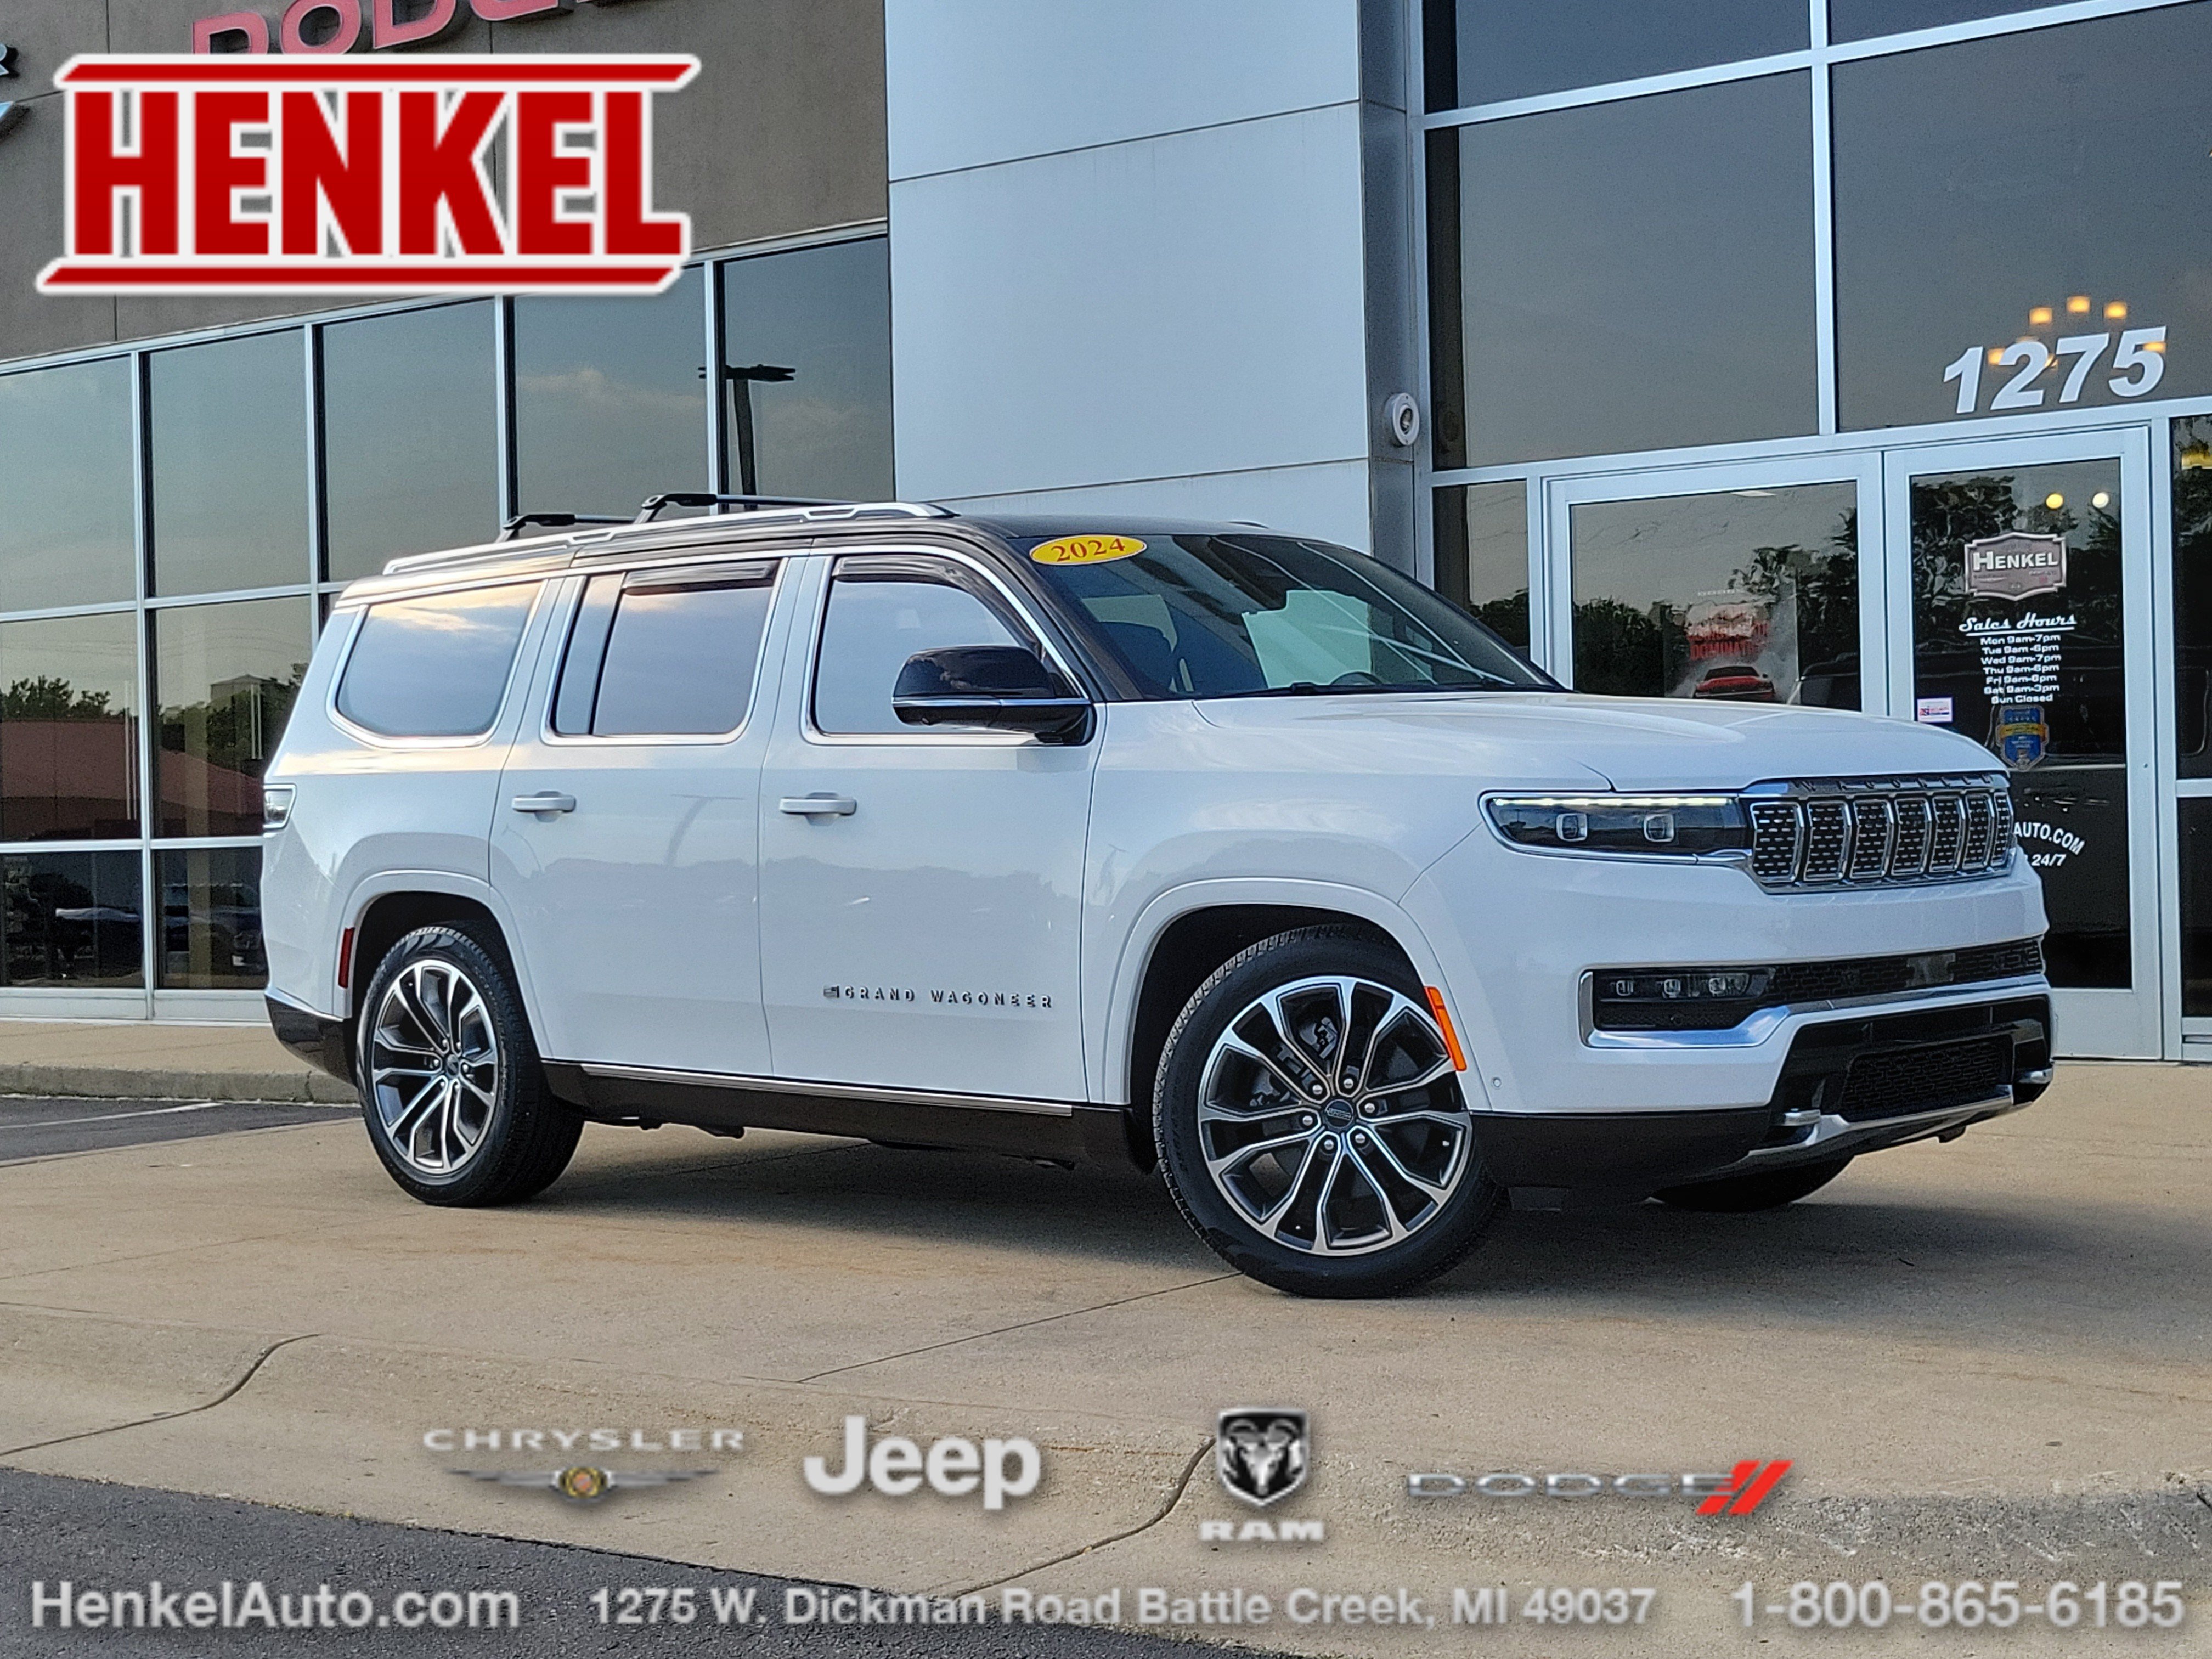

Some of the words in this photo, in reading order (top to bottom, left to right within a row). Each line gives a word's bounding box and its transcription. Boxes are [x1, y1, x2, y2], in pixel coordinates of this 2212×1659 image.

[1943, 325, 2166, 414] 1275
[1051, 537, 1125, 562] 2024
[1972, 550, 2058, 572] HENKEL
[1959, 617, 2012, 631] Sales
[2016, 612, 2078, 628] Hours
[1980, 636, 2005, 645] Mon
[1981, 656, 2006, 665] Wed
[1983, 667, 2004, 675] Thu
[2015, 693, 2053, 703] Closed
[2031, 853, 2067, 866] 24/7
[845, 985, 916, 1002] GRAND
[931, 989, 1052, 1008] WAGONEER
